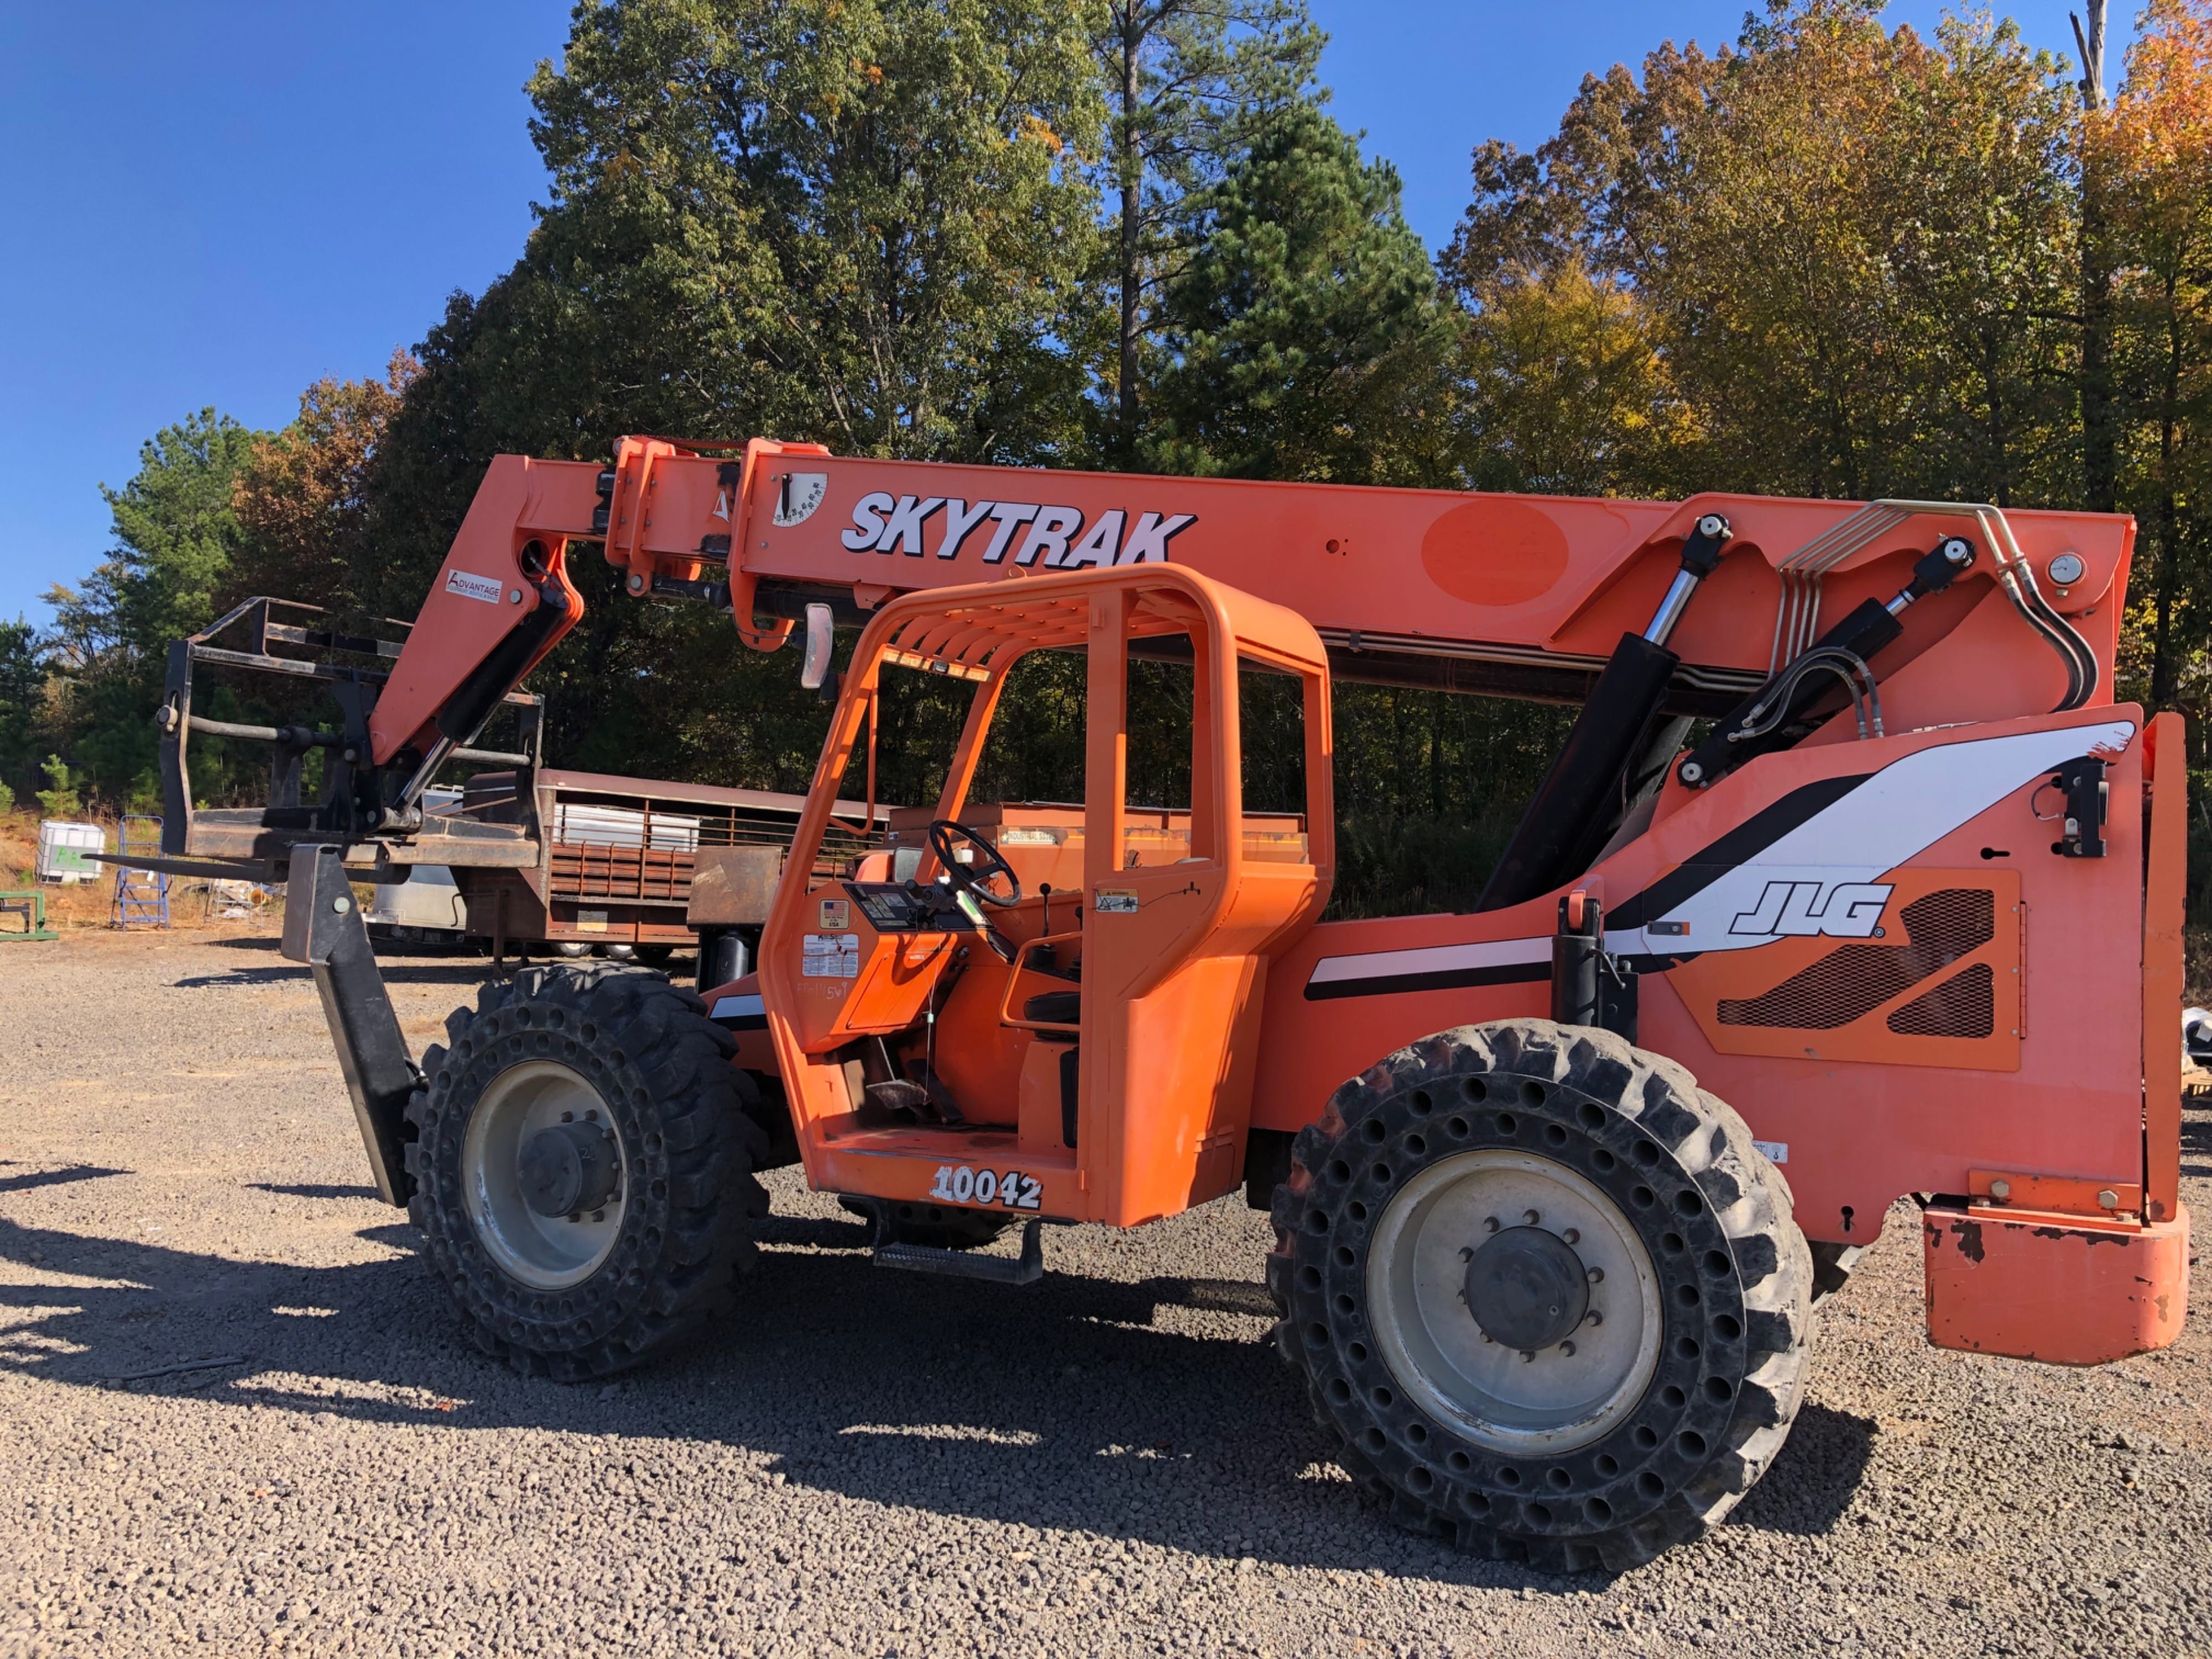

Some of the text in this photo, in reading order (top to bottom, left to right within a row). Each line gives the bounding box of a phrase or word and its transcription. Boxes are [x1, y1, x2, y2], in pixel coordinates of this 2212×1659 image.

[841, 491, 1198, 569] SKYTRAK
[448, 571, 500, 596] ADVANTAGE
[1728, 880, 1896, 938] JLG
[928, 1165, 1044, 1211] 10042
